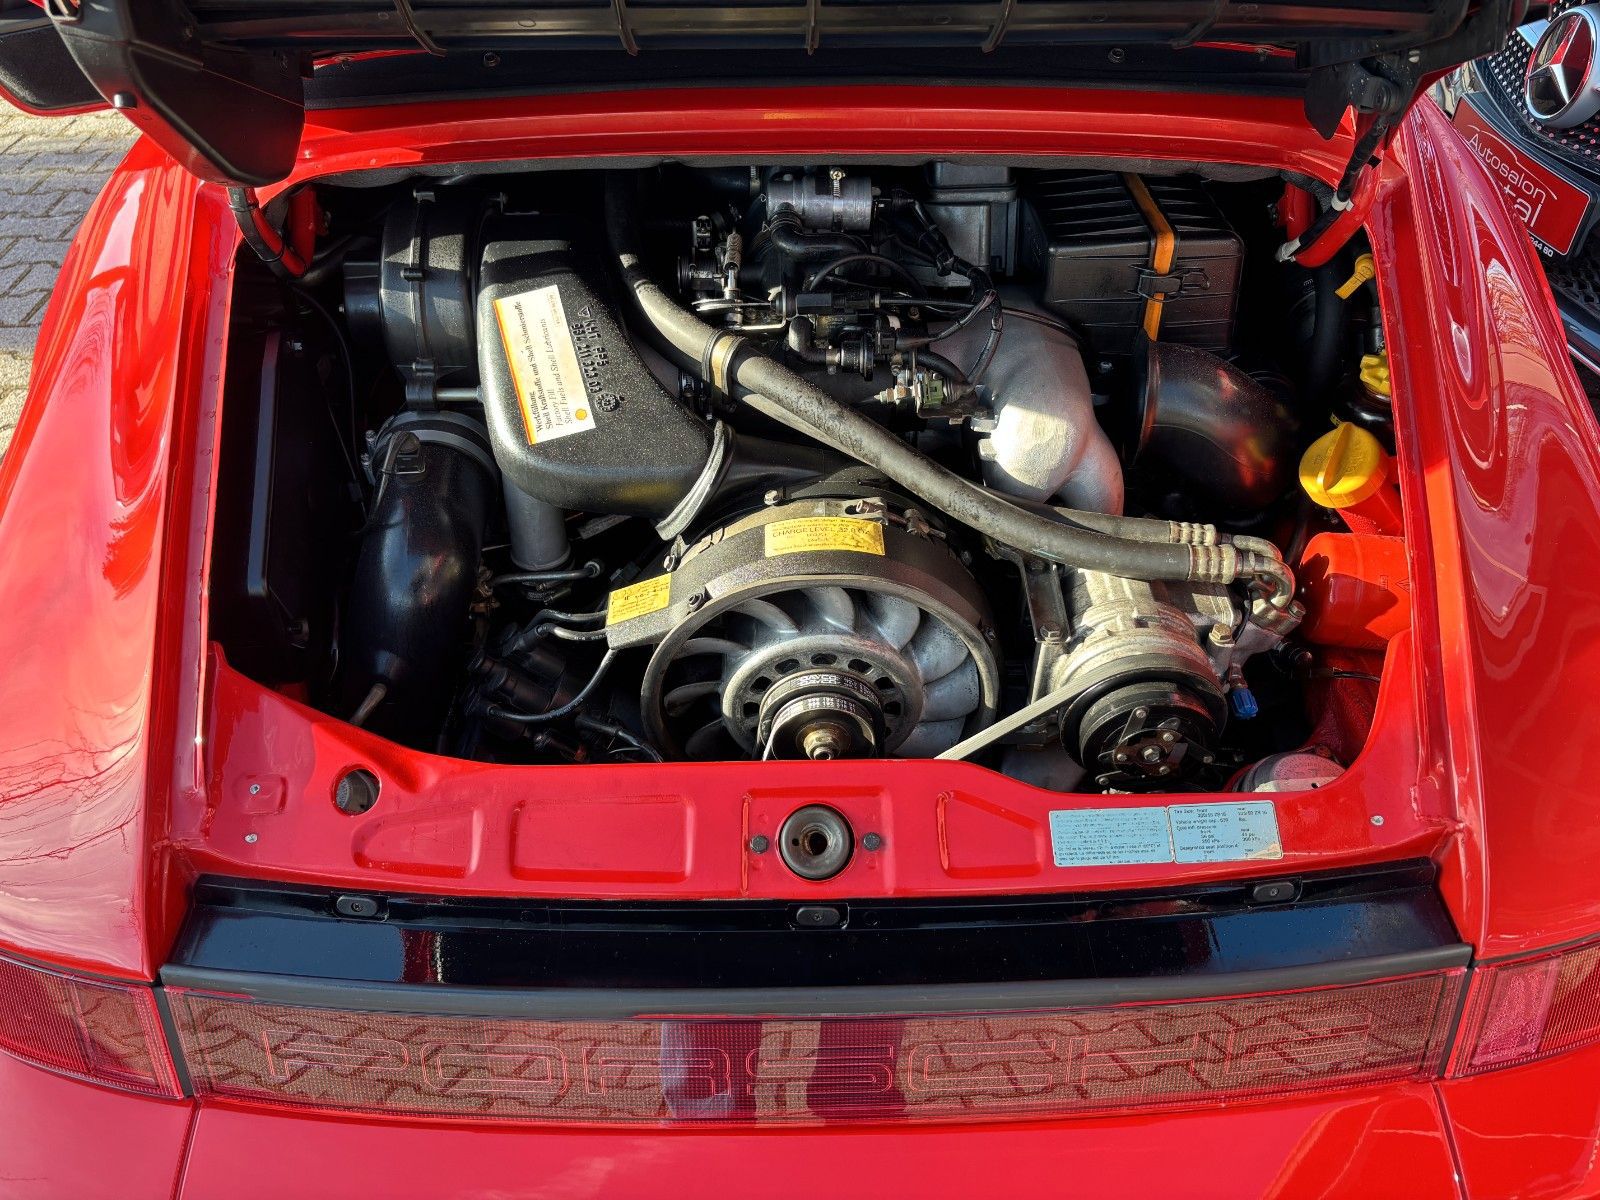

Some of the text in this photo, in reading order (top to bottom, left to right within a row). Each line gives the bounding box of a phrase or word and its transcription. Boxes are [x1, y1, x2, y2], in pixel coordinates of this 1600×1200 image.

[1468, 134, 1546, 203] Autosalon
[527, 344, 536, 362] Shell
[531, 362, 540, 377] und
[549, 354, 559, 372] Shell
[535, 376, 549, 411] Kraftstoffe
[558, 387, 568, 406] Fuels
[544, 411, 554, 430] Shell
[552, 400, 564, 427] Factory
[564, 406, 573, 425] Shell
[263, 1012, 1371, 1096] PORSCHE
